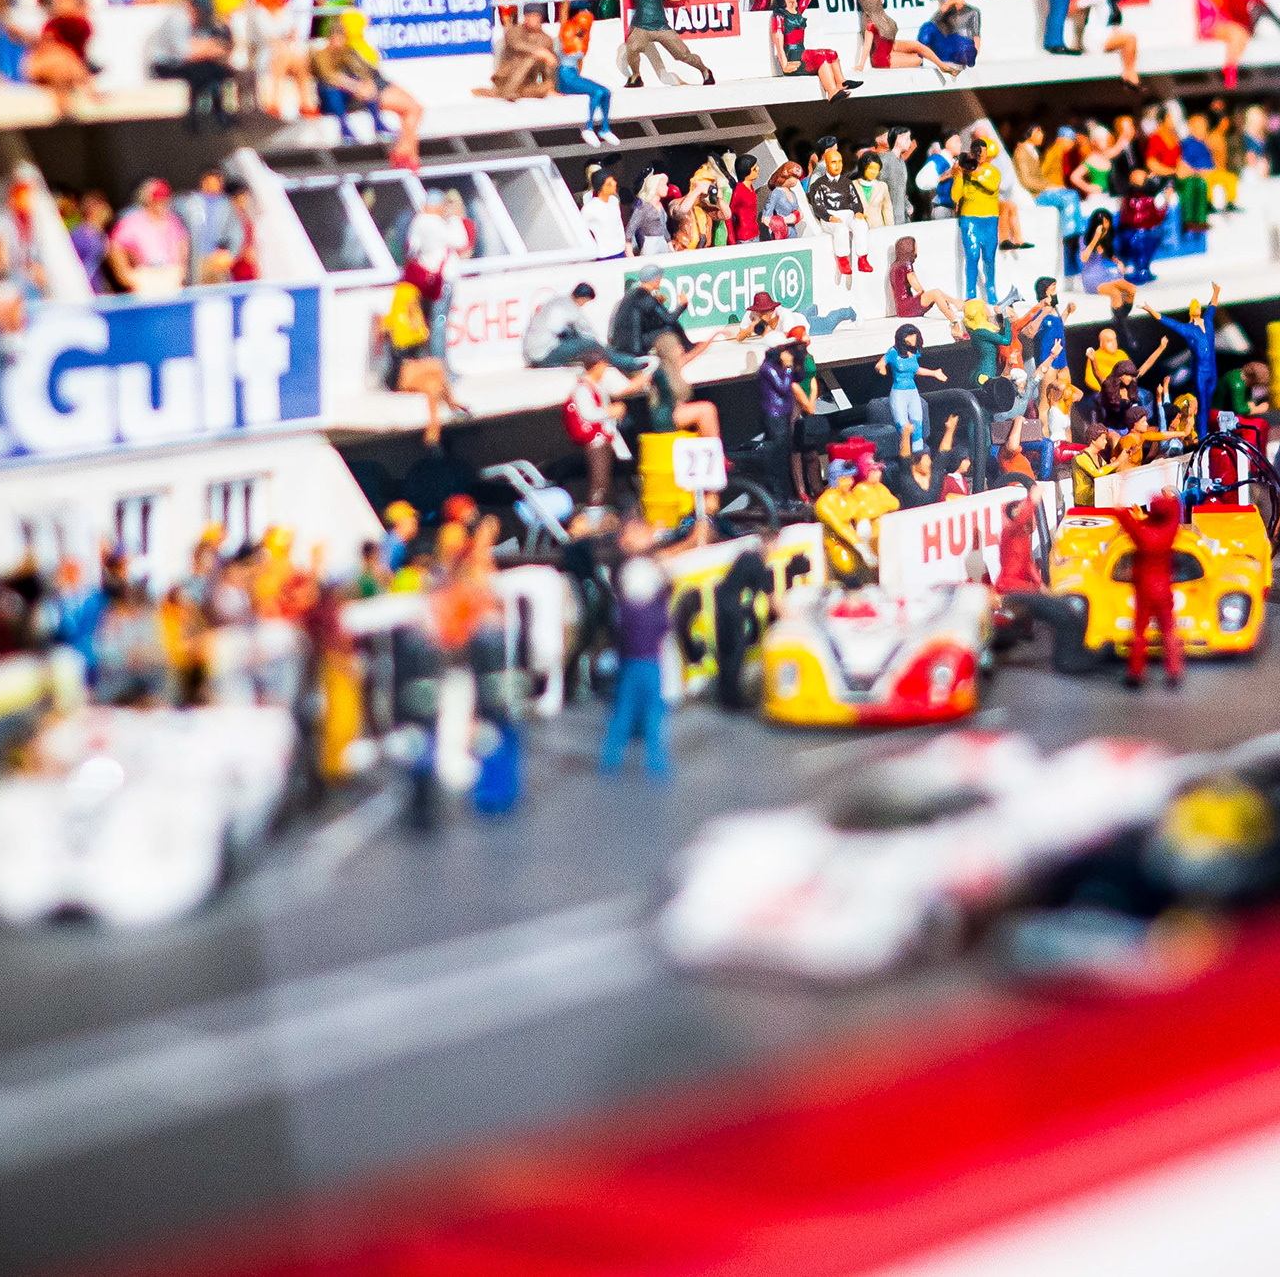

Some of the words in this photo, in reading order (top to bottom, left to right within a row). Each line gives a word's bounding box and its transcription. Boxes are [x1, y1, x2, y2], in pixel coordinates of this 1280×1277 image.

[627, 3, 733, 32] NAULT
[656, 266, 767, 318] ORSCHE
[778, 268, 800, 300] 18
[445, 299, 520, 347] SCHE
[2, 286, 296, 450] Gulf
[683, 447, 714, 477] 27
[922, 506, 1002, 564] HUIL
